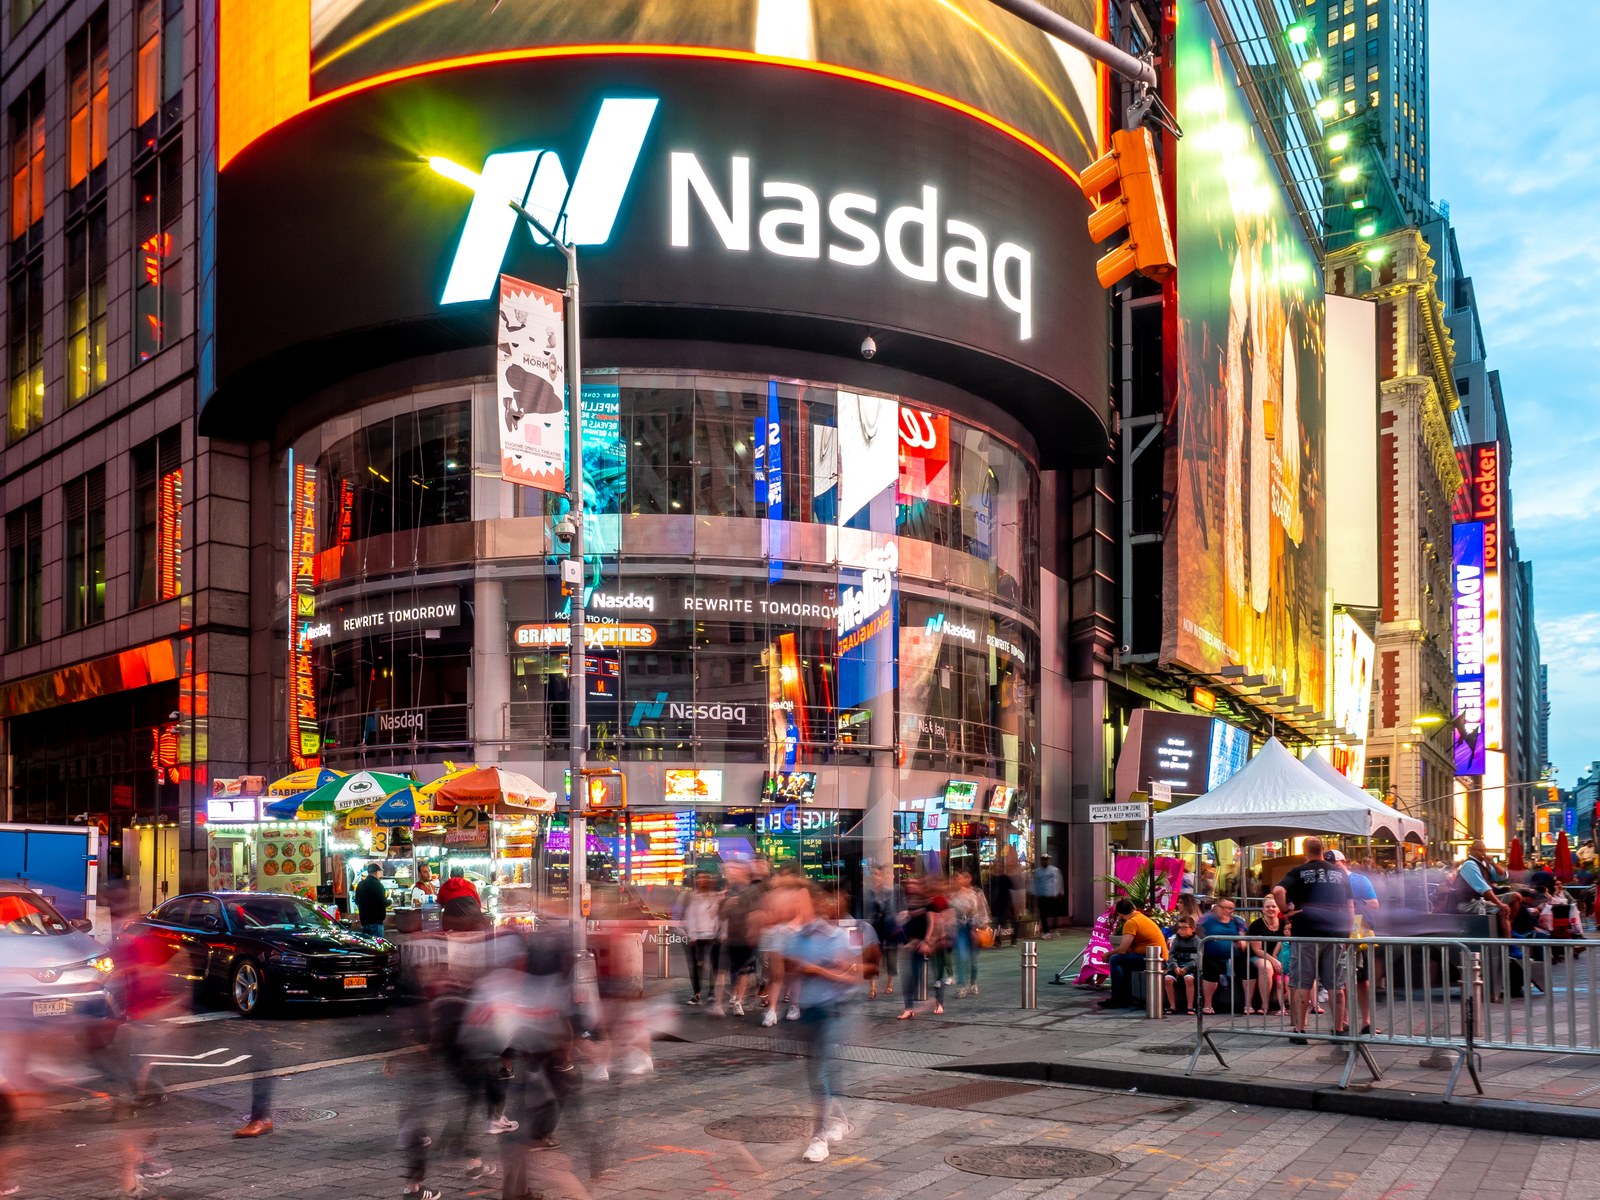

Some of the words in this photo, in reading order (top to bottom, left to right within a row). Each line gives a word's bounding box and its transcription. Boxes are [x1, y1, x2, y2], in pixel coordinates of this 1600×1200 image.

[671, 151, 1031, 340] Nasdaq
[1475, 447, 1496, 518] Locker
[593, 592, 654, 612] Nasdaq
[685, 598, 753, 612] REWRITE
[760, 601, 840, 618] TOMORROW
[343, 613, 385, 631] REWRITE
[388, 604, 456, 625] TOMORROW
[1456, 564, 1481, 675] ADVERTISE
[943, 620, 976, 643] Nasdaq
[380, 710, 423, 731] Nasdaq
[670, 703, 746, 724] Nasdaq
[353, 798, 366, 807] PARK
[1091, 804, 1118, 813] PEDESTRIAN
[1118, 803, 1130, 812] FLOW
[1130, 803, 1142, 811] ZONE
[1113, 812, 1125, 820] KEEP
[1125, 811, 1142, 820] MOVING
[649, 933, 688, 945] Ndaq
